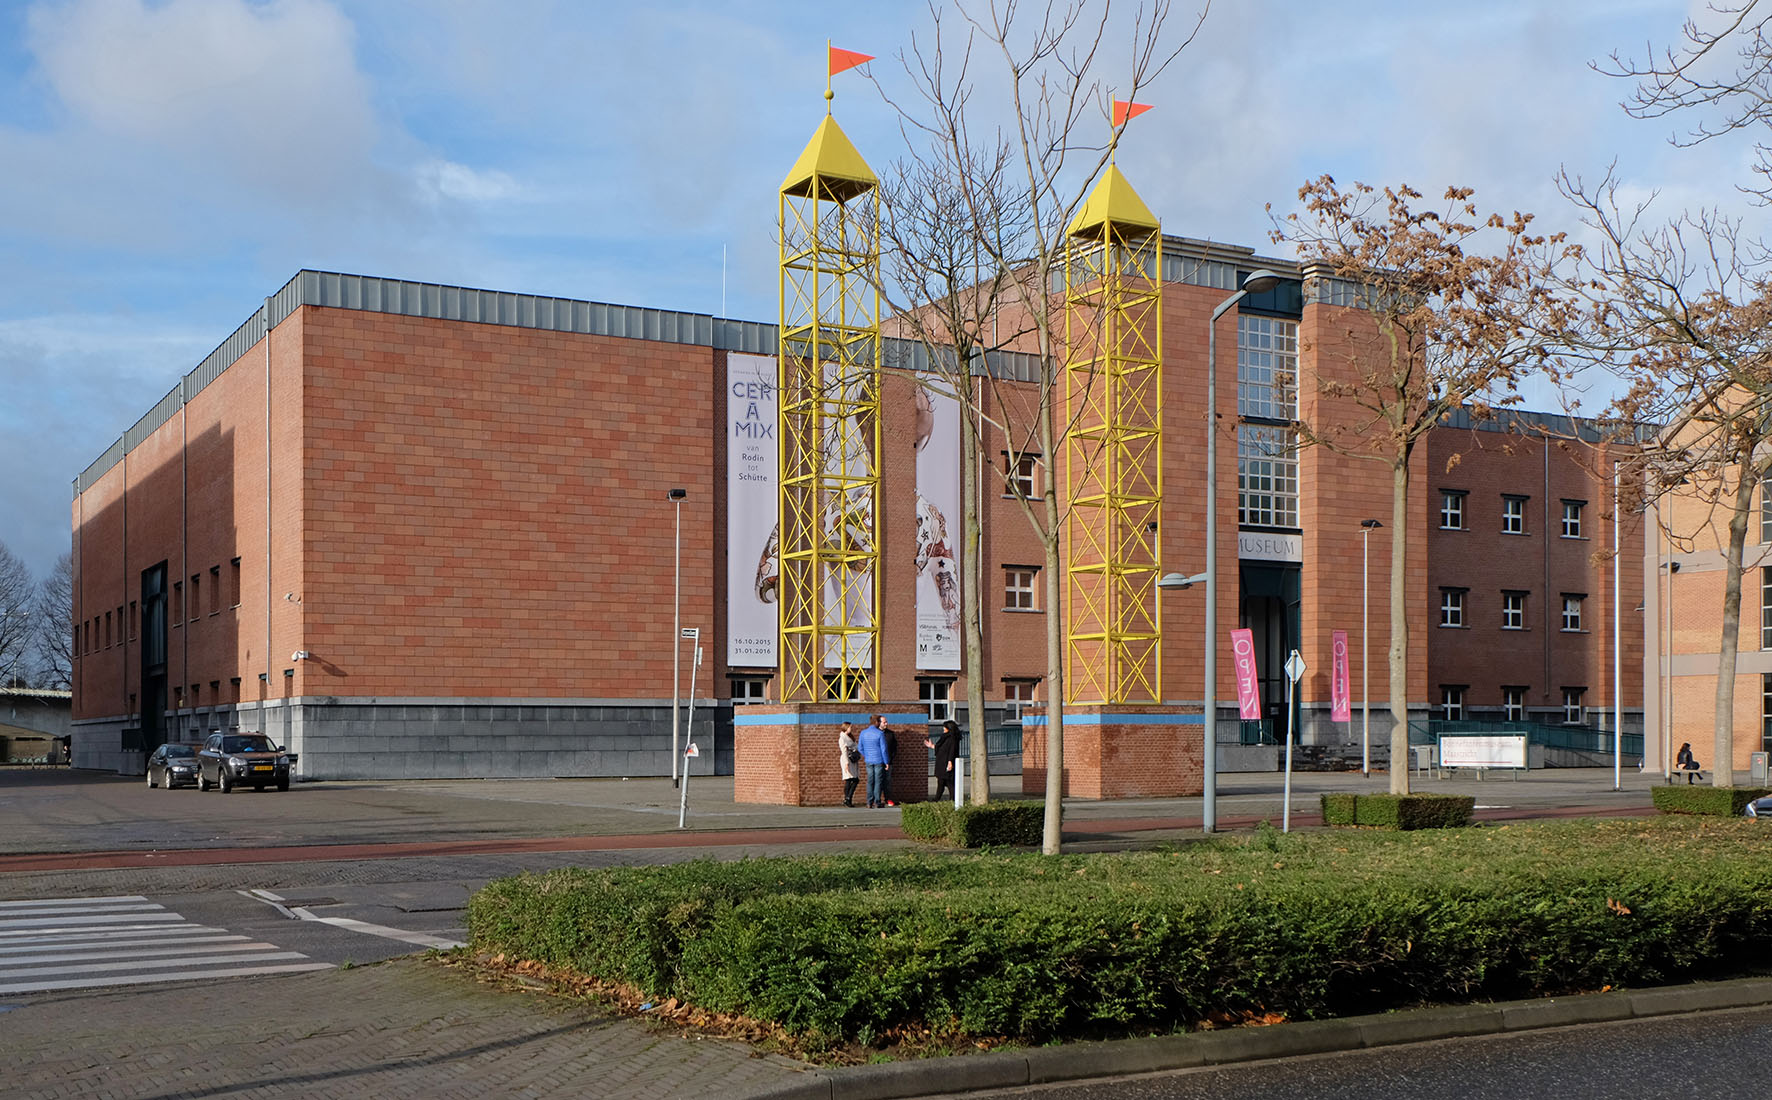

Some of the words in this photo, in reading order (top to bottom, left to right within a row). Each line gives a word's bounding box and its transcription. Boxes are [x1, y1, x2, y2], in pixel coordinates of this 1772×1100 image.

[735, 422, 773, 439] MIX
[742, 453, 764, 462] Rodin
[738, 473, 767, 482] Schütte
[735, 638, 771, 646] 16.10.2015
